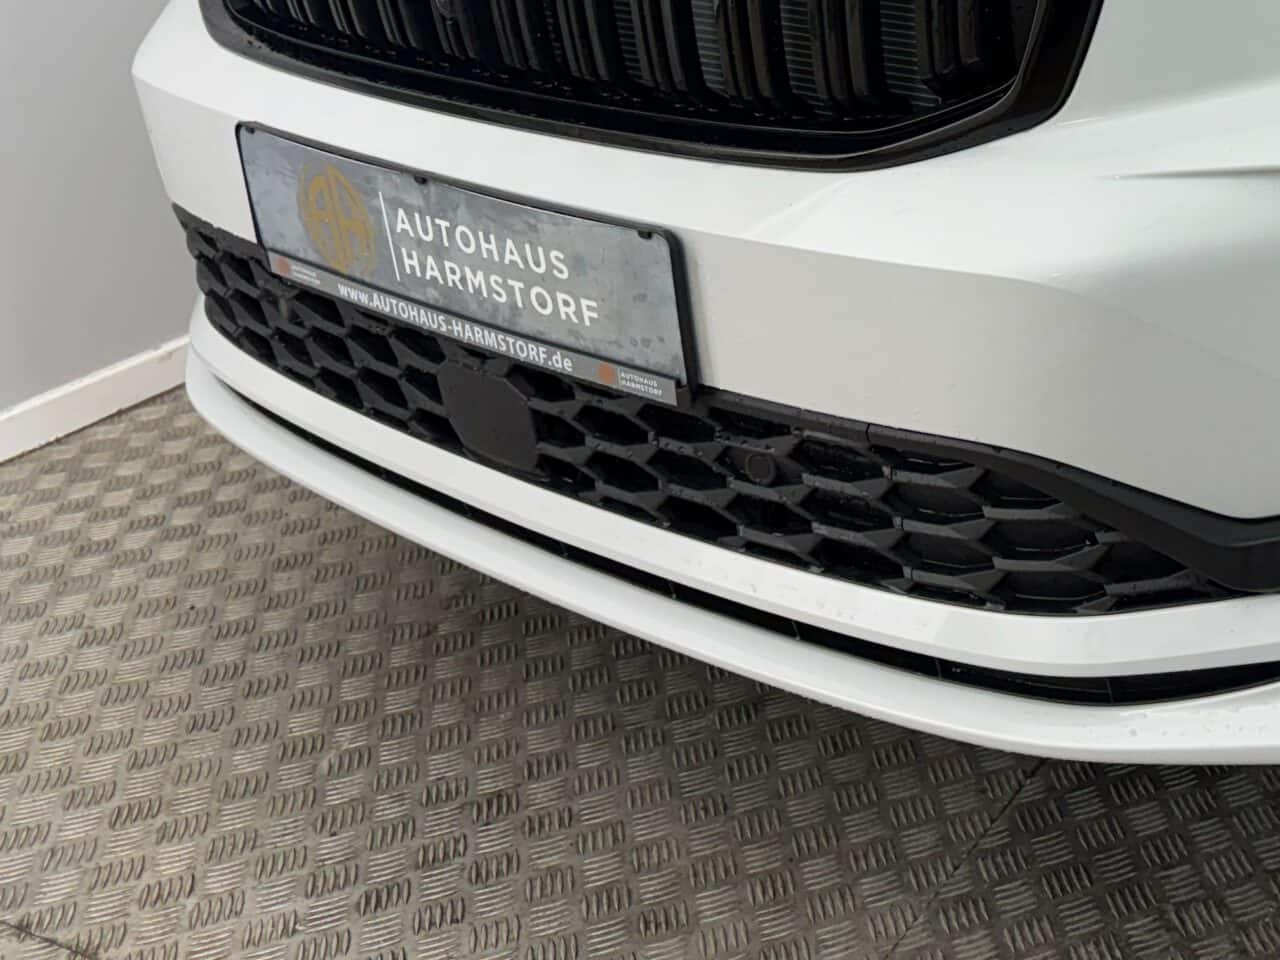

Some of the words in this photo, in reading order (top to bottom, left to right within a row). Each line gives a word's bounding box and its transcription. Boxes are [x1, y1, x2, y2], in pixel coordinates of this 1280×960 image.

[396, 208, 569, 280] AUTOHAUS
[402, 247, 600, 327] HARMSTORF
[337, 282, 574, 373] www.AUTOHAUS-HARMSTORF.de
